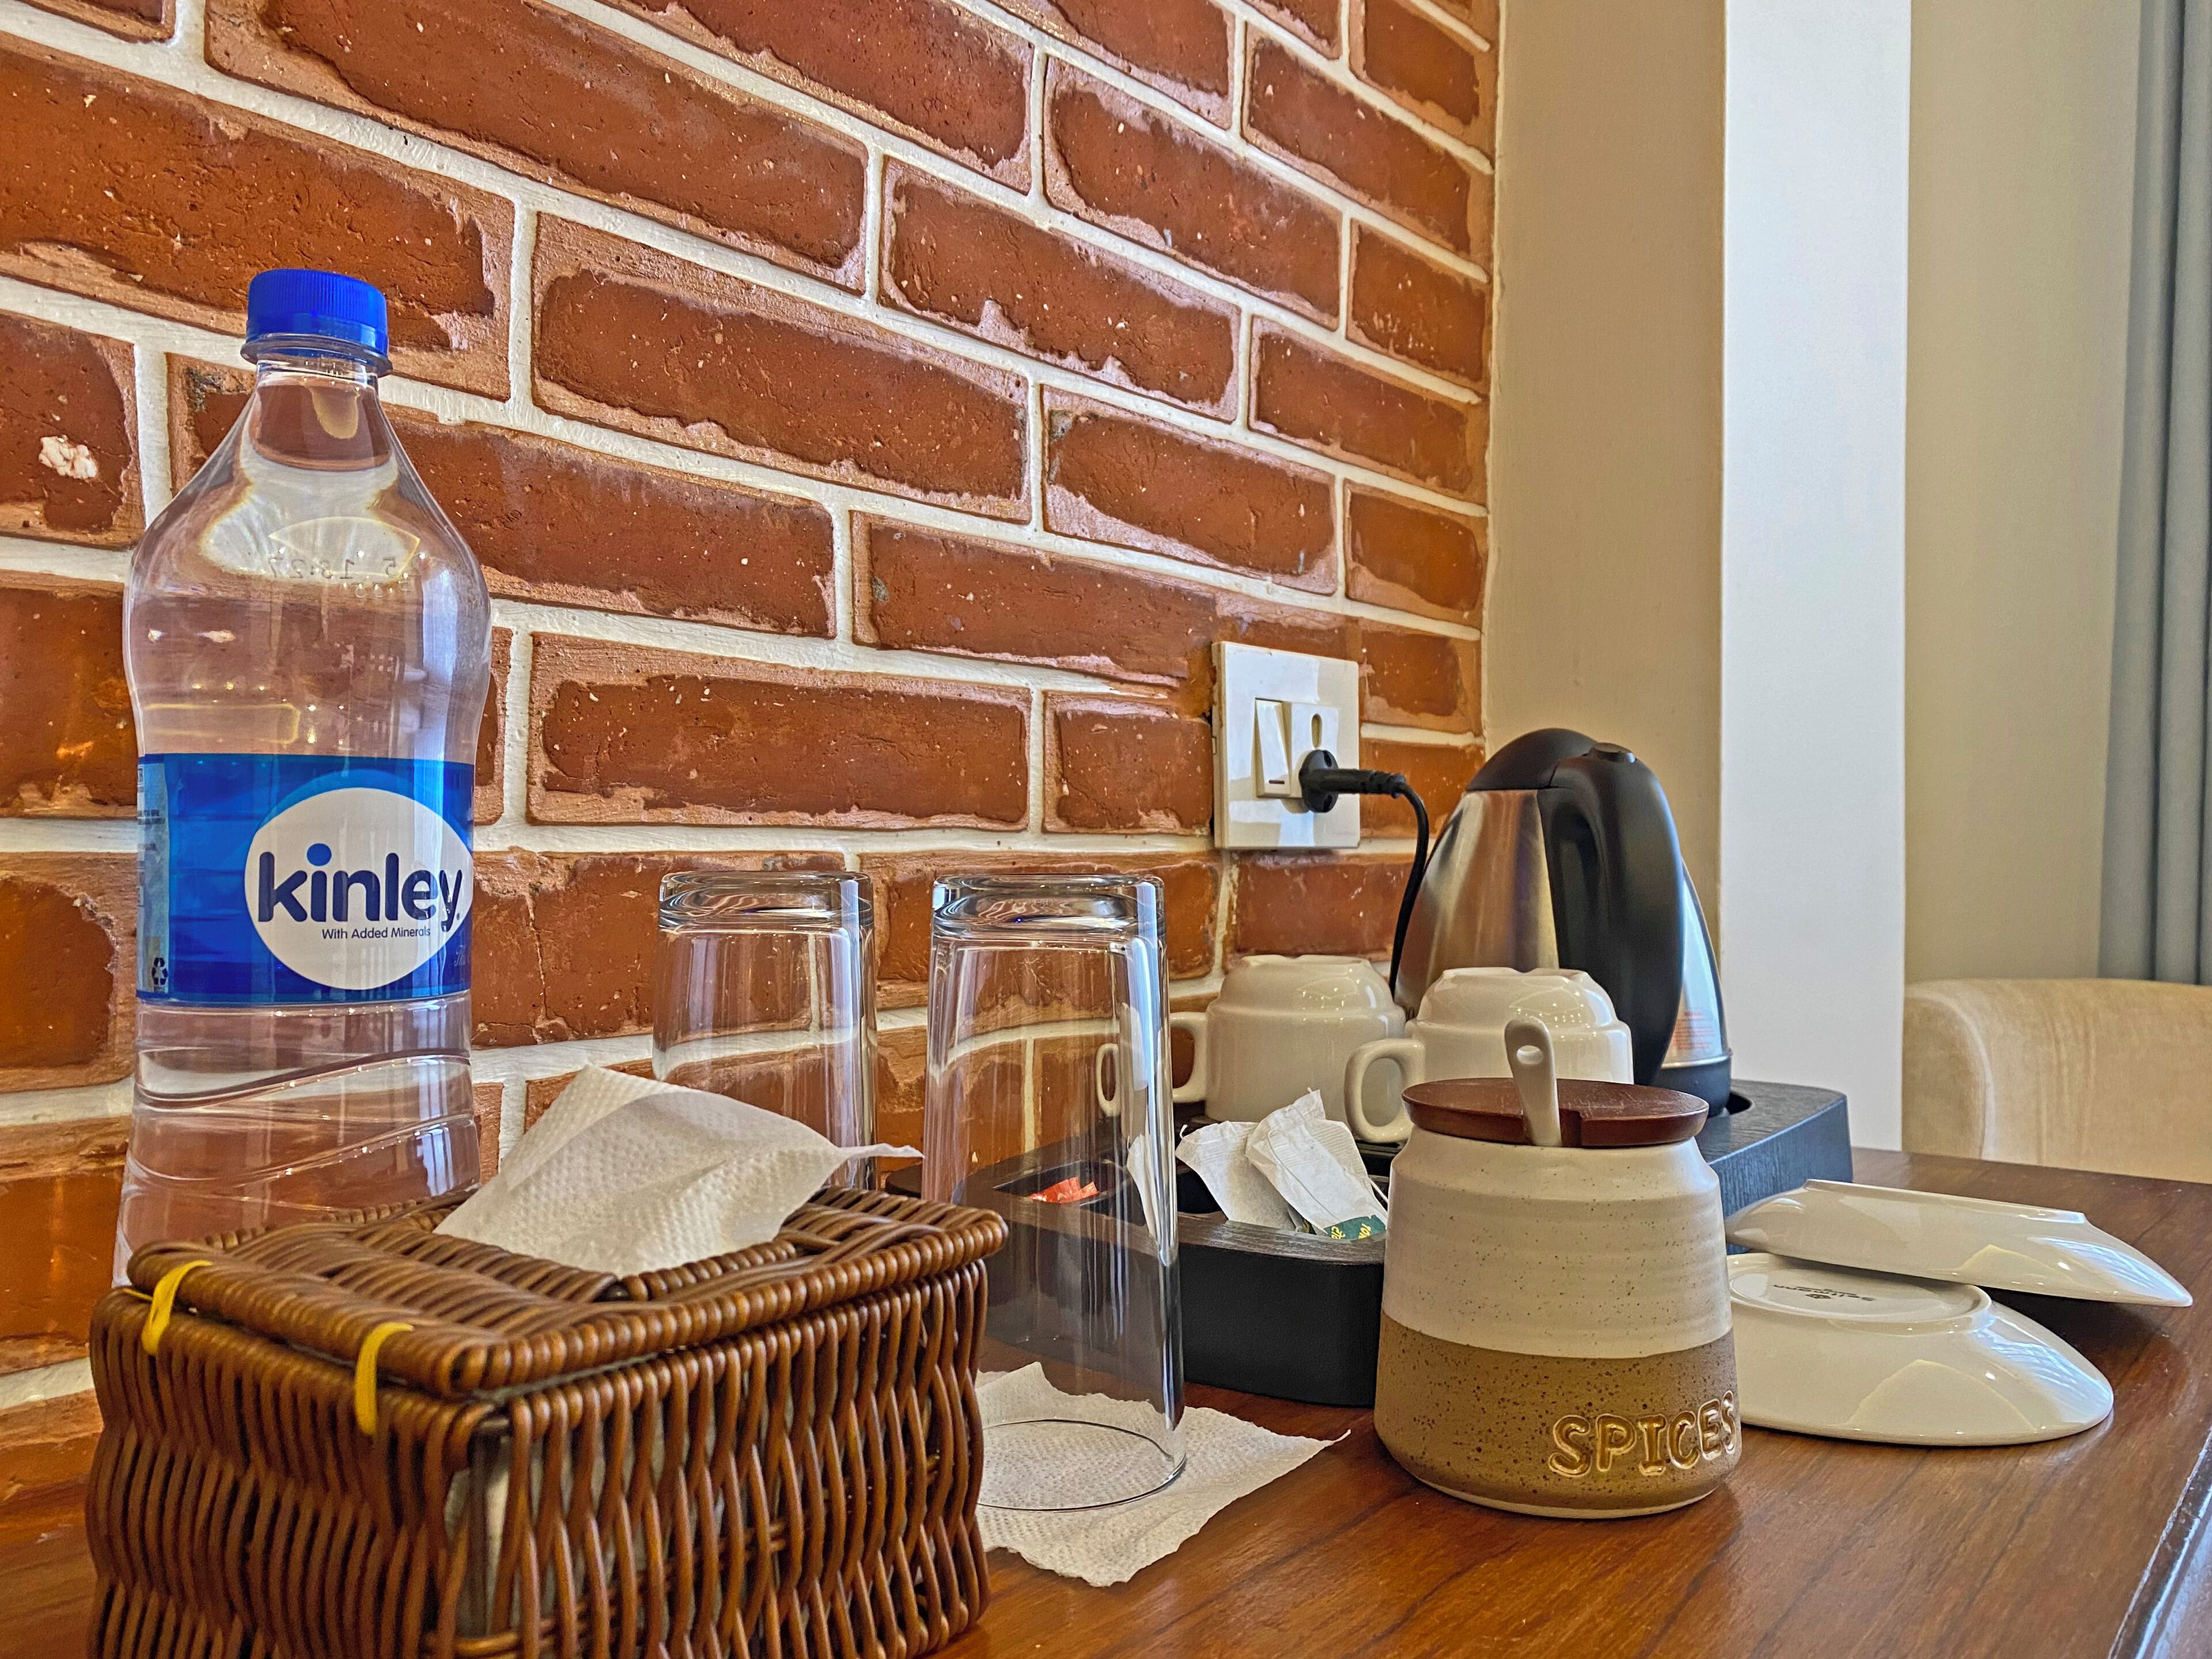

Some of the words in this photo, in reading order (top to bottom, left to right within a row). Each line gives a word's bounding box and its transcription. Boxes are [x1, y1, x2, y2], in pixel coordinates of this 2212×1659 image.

[258, 843, 463, 933] kinley
[322, 928, 347, 939] With
[351, 926, 388, 939] Added
[391, 925, 431, 938] Minerals
[1548, 1390, 1736, 1478] SPICES
